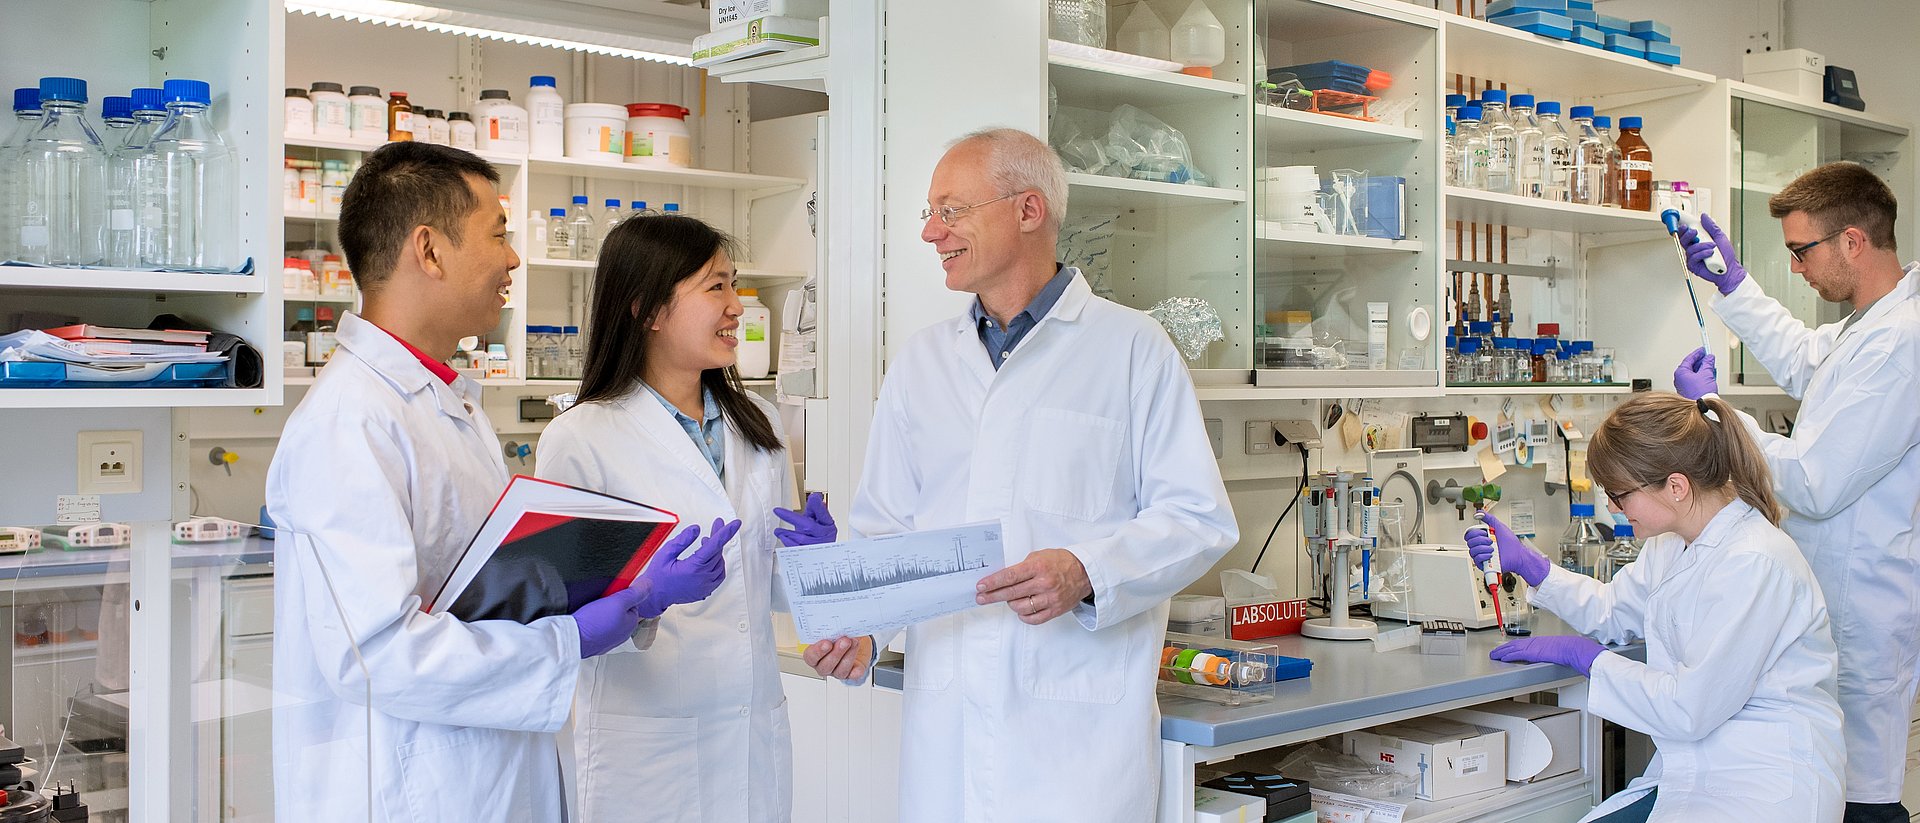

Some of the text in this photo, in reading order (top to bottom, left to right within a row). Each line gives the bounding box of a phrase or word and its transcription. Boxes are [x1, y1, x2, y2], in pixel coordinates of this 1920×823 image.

[718, 5, 736, 15] Dry Ice
[718, 13, 738, 24] UN1845
[1232, 600, 1307, 626] LABSOLUTE
